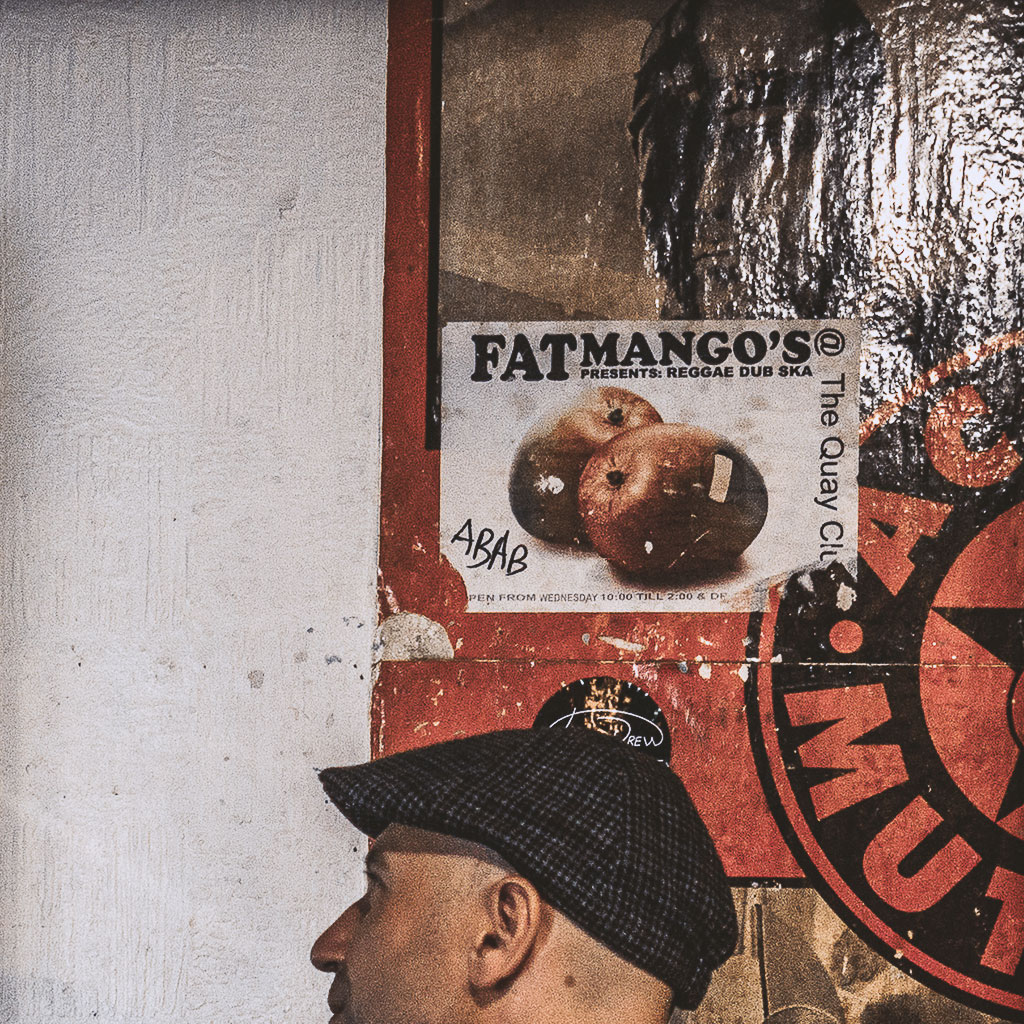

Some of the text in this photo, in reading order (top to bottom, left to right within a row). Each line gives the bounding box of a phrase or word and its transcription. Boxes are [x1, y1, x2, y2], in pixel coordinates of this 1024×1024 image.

[580, 365, 813, 379] PRESENTS: REGGAE DUB SKA
[820, 373, 845, 427] The
[814, 437, 845, 511] Quay
[820, 521, 843, 561] Clu
[469, 594, 495, 602] PEN
[499, 593, 536, 601] FROM
[540, 593, 597, 603] WEDNESDAY
[601, 593, 633, 601] 10:00
[784, 683, 1024, 976] MUT
